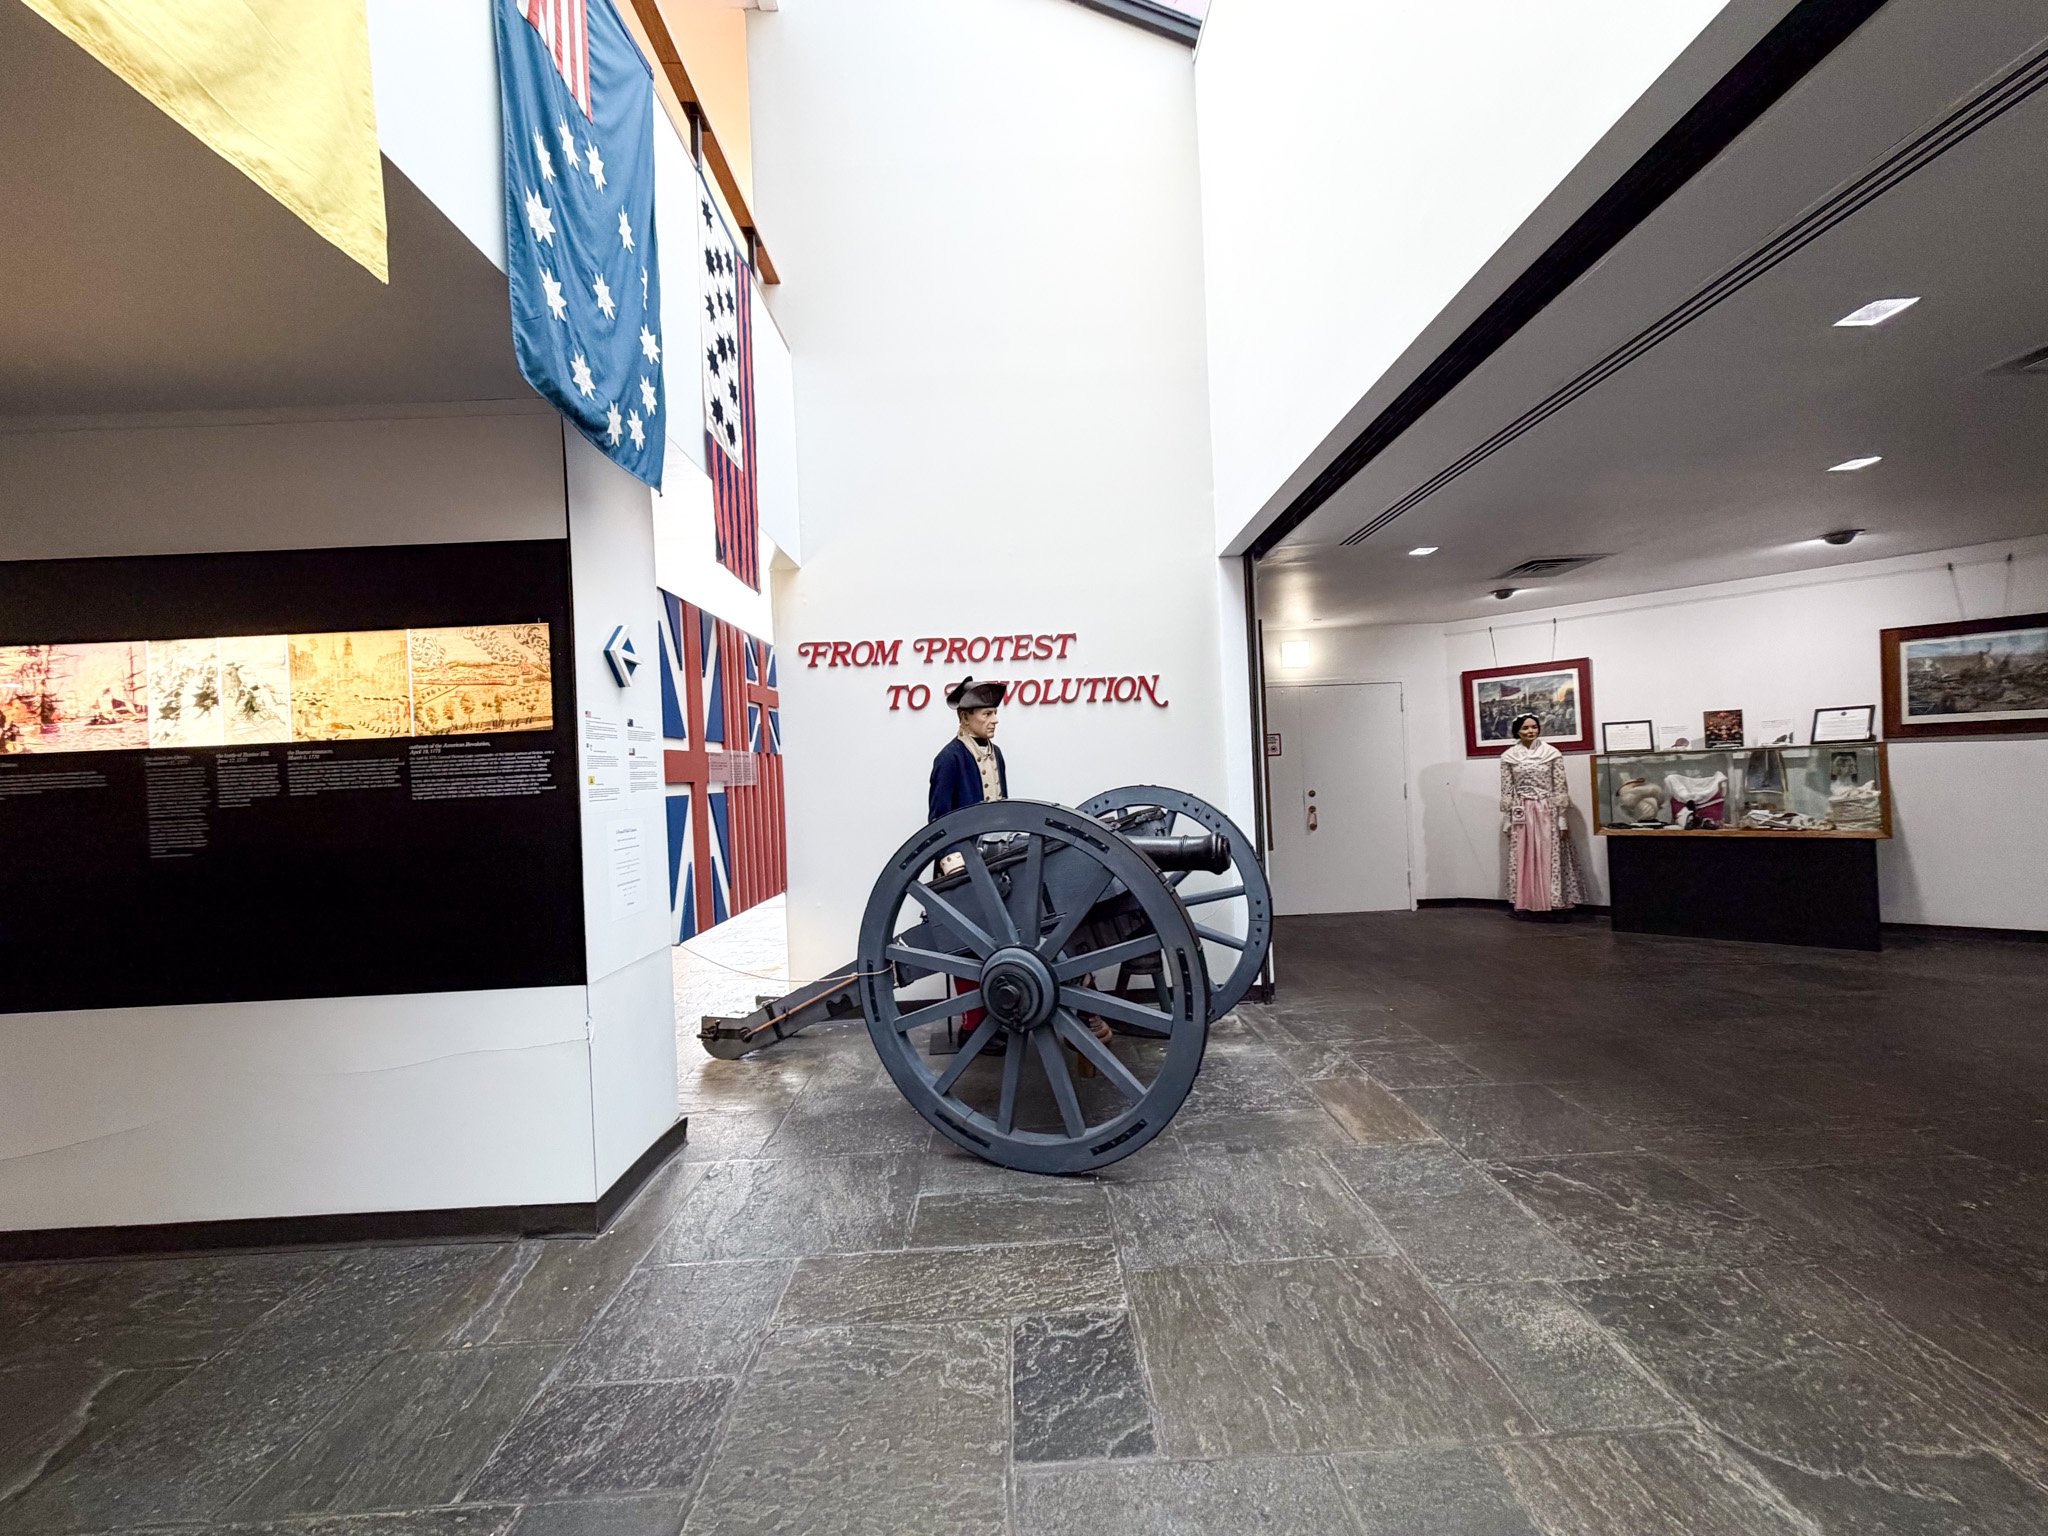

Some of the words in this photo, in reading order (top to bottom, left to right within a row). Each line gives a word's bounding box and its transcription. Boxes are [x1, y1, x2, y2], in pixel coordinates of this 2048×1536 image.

[798, 639, 903, 668] FROM
[913, 633, 1077, 664] PROTEST
[887, 684, 931, 711] TO
[944, 674, 1169, 708] VOLUTION
